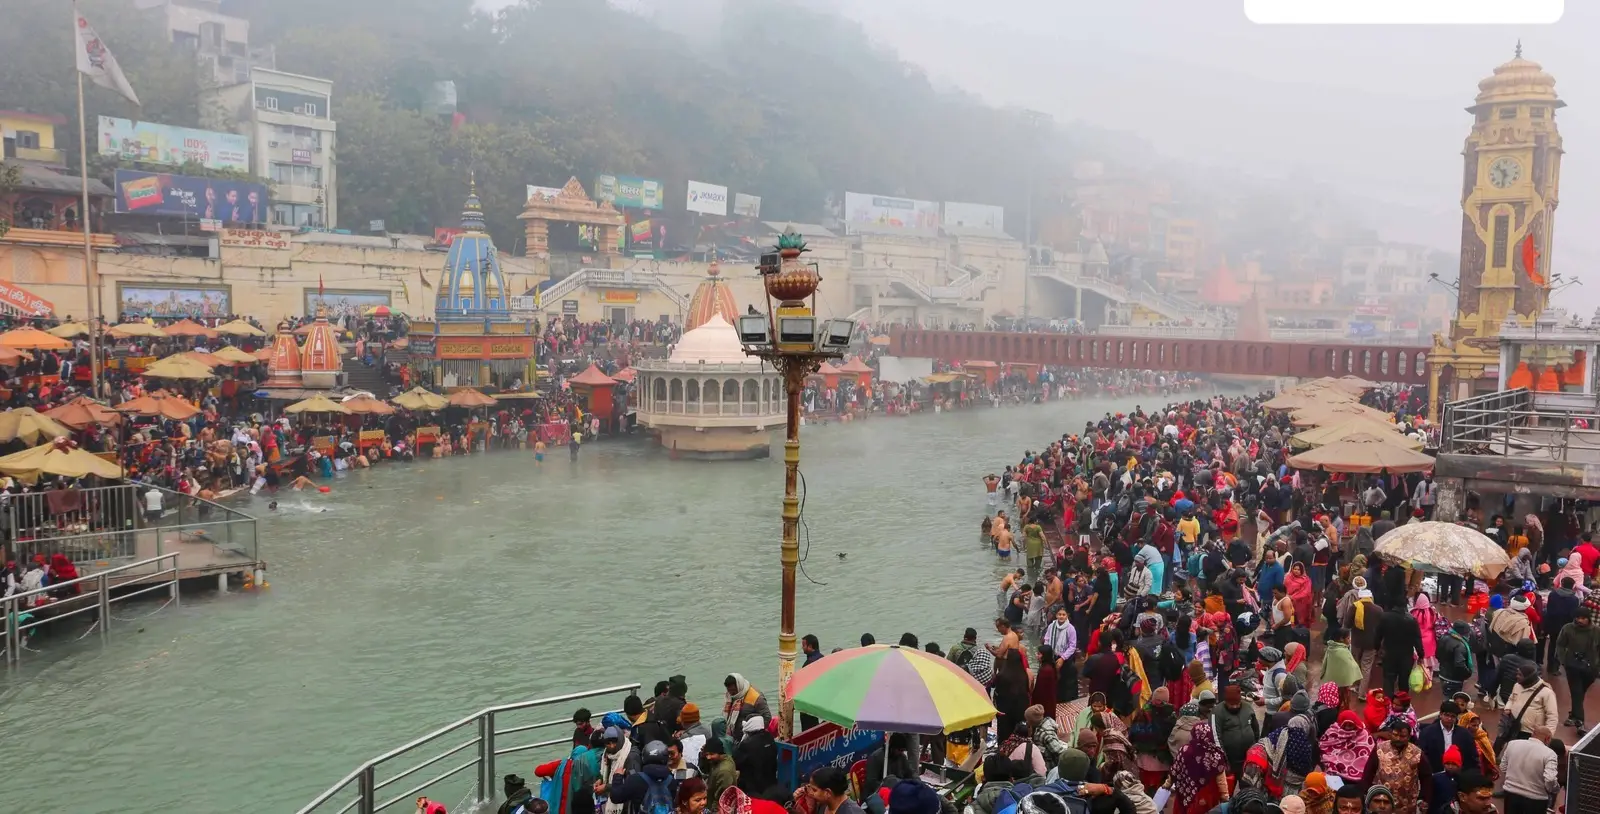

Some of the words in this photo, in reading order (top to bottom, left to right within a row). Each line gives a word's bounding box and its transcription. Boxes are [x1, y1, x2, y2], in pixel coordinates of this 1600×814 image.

[183, 138, 209, 149] 100%
[798, 729, 838, 762] यातायात
[830, 751, 855, 769] हरिद्वार
